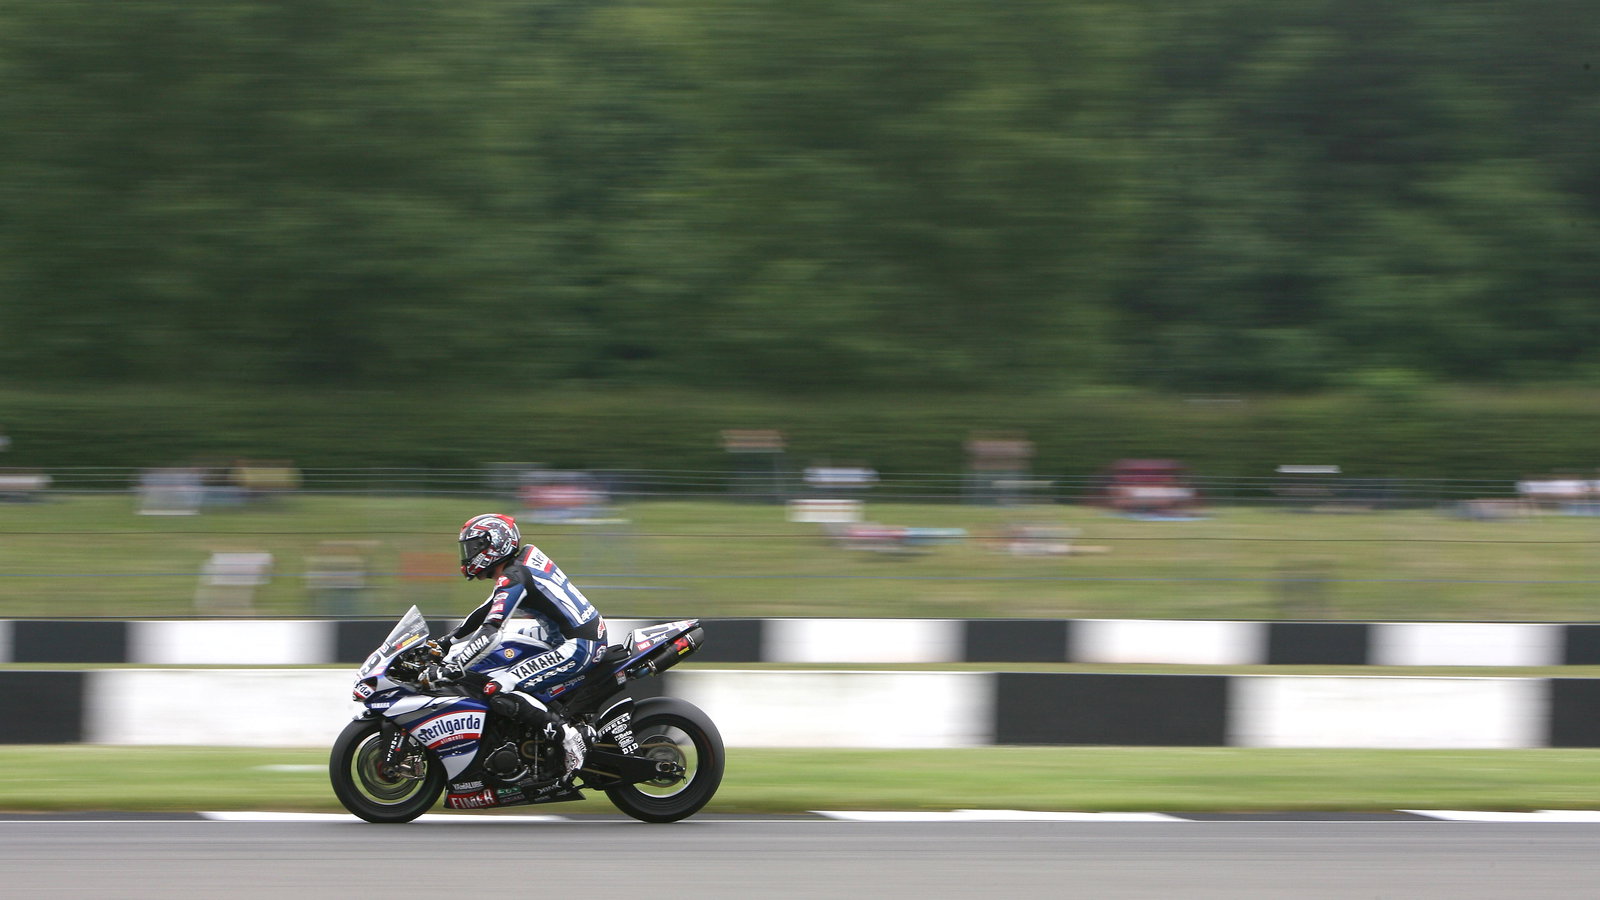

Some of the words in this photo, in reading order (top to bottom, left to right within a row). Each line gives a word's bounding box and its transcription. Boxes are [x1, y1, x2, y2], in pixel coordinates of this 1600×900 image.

[511, 650, 565, 679] YAMAHA
[418, 715, 480, 743] sterilgarda
[451, 789, 495, 809] FIMER
